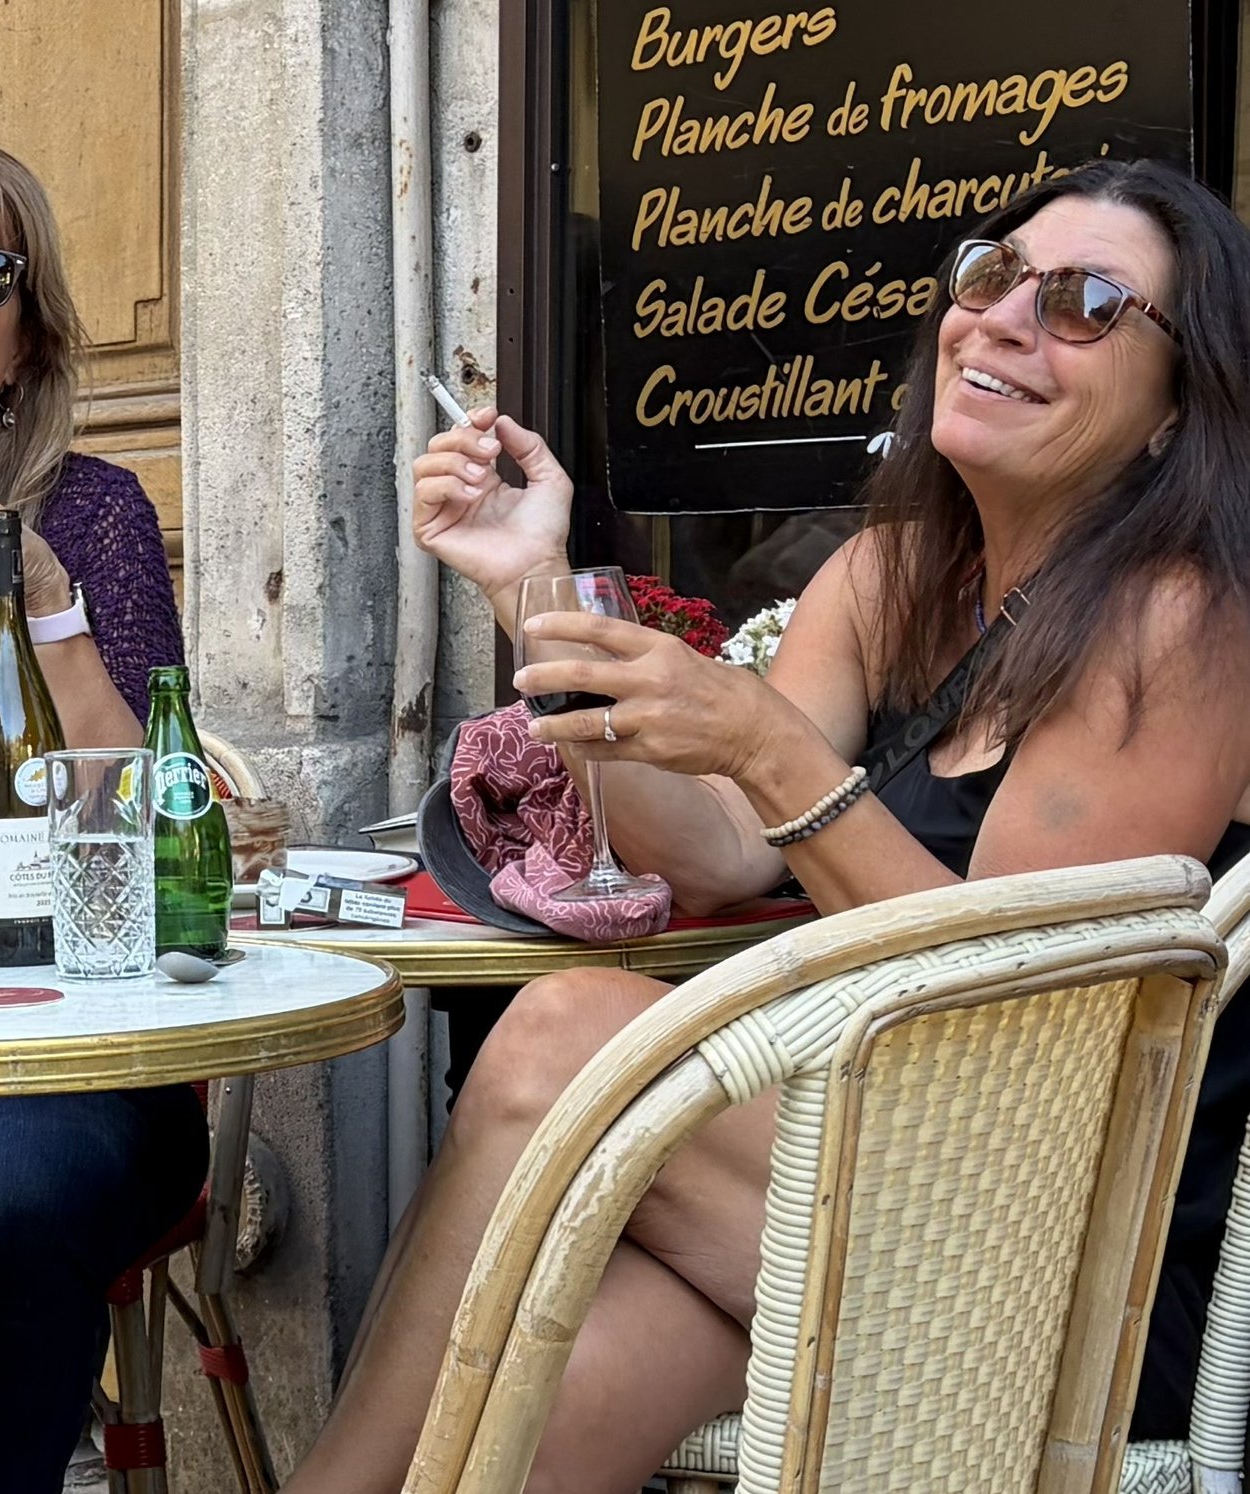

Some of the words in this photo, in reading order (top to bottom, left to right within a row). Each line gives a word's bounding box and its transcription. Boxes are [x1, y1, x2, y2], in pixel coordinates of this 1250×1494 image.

[631, 7, 837, 90] Burgers
[632, 82, 814, 161] Planche
[827, 81, 869, 136] de
[880, 60, 1129, 146] fromages
[631, 175, 812, 251] Planche
[822, 178, 863, 232] de
[872, 143, 1109, 224] charcut
[633, 269, 787, 339] Salade
[804, 261, 938, 325] Césa
[636, 355, 888, 427] Croustillant
